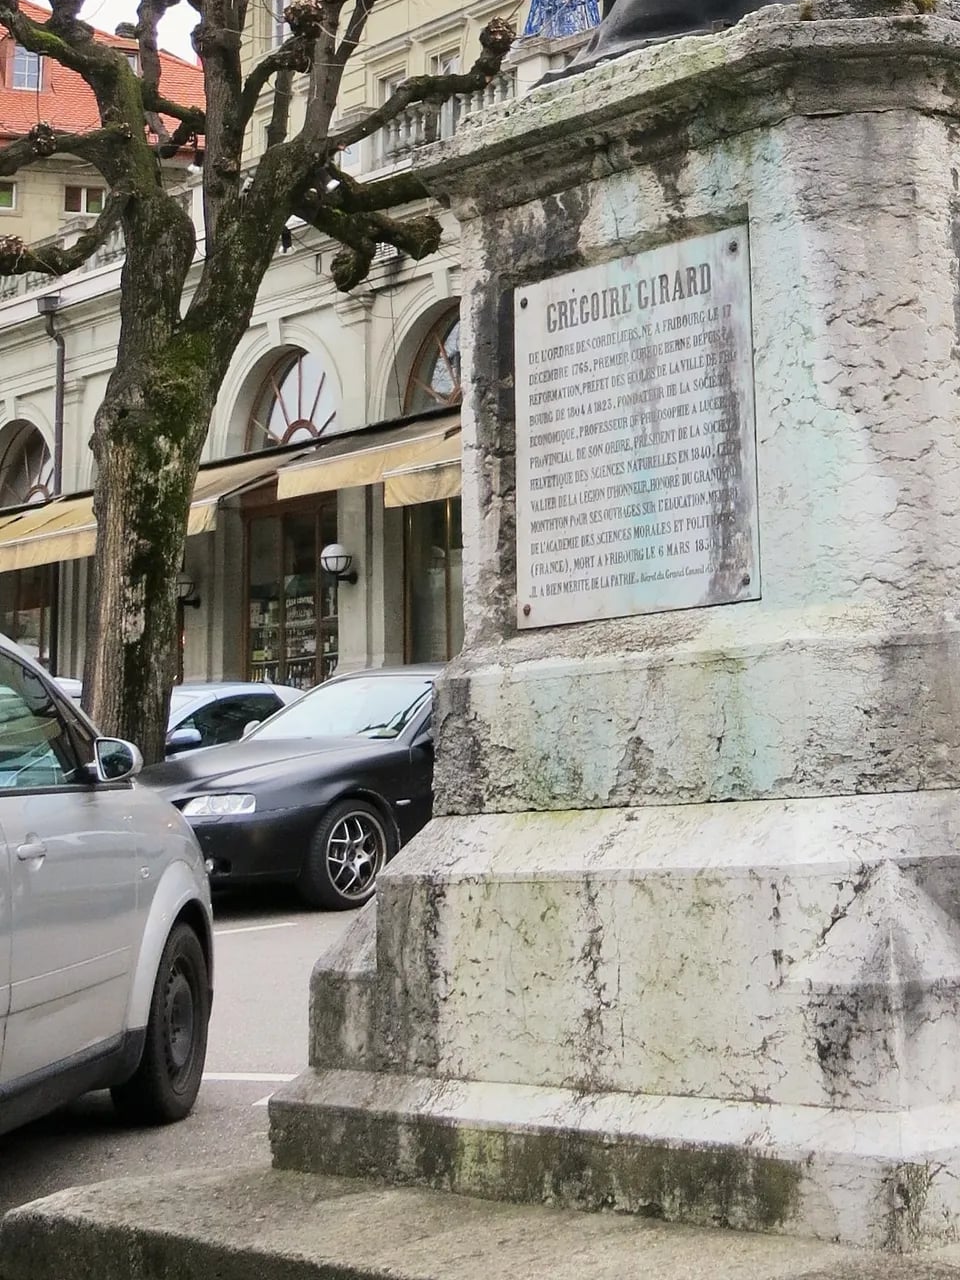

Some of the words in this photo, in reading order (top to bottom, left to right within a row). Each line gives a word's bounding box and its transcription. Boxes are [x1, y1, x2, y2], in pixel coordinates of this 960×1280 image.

[638, 263, 711, 310] GIRARD
[529, 352, 539, 365] DE
[541, 343, 575, 362] L'ORDRE
[576, 338, 591, 353] DES
[662, 310, 705, 332] FRIBOURG
[708, 306, 719, 321] LE
[593, 352, 629, 371] PREMIER
[653, 343, 663, 356] DE
[664, 336, 692, 355] BERNE
[693, 329, 720, 348] DEPUIS
[611, 373, 625, 388] DES
[657, 364, 667, 377] DE
[669, 361, 680, 375] LA
[680, 356, 705, 372] VILLE
[706, 352, 717, 367] DE
[530, 410, 554, 427] BOURG
[555, 408, 565, 421] DE
[617, 386, 664, 408] FONDATEUR
[666, 383, 677, 397] DE
[680, 381, 690, 395] LA
[580, 416, 628, 437] PROFESSEUR
[641, 403, 690, 425] PHILOSOPHIE
[576, 446, 586, 460] DE
[587, 442, 603, 458] SON
[678, 426, 687, 440] DE
[690, 425, 700, 438] LA
[575, 469, 588, 483] DES
[591, 461, 625, 478] SCIENCES
[627, 452, 677, 473] NATURELLES
[678, 448, 689, 463] EN
[531, 497, 556, 512] VALIER
[558, 494, 567, 508] DE
[568, 493, 577, 506] LA
[682, 471, 692, 486] DU
[693, 467, 721, 484] GRAND
[570, 512, 587, 528] POUR
[589, 510, 603, 525] SES
[603, 503, 641, 521] OUVRAGES
[642, 500, 656, 515] SUR
[531, 542, 539, 556] DE
[581, 533, 595, 548] DES
[596, 527, 632, 545] SCIENCES
[633, 521, 671, 540] MORALES
[674, 518, 683, 533] ET
[574, 555, 596, 572] MORT
[605, 549, 644, 567] FRIBOURG
[646, 545, 655, 561] LE
[658, 545, 664, 558] 6
[666, 540, 690, 557] MARS
[546, 582, 561, 596] BIEN
[591, 577, 599, 590] DE
[600, 576, 609, 589] LA
